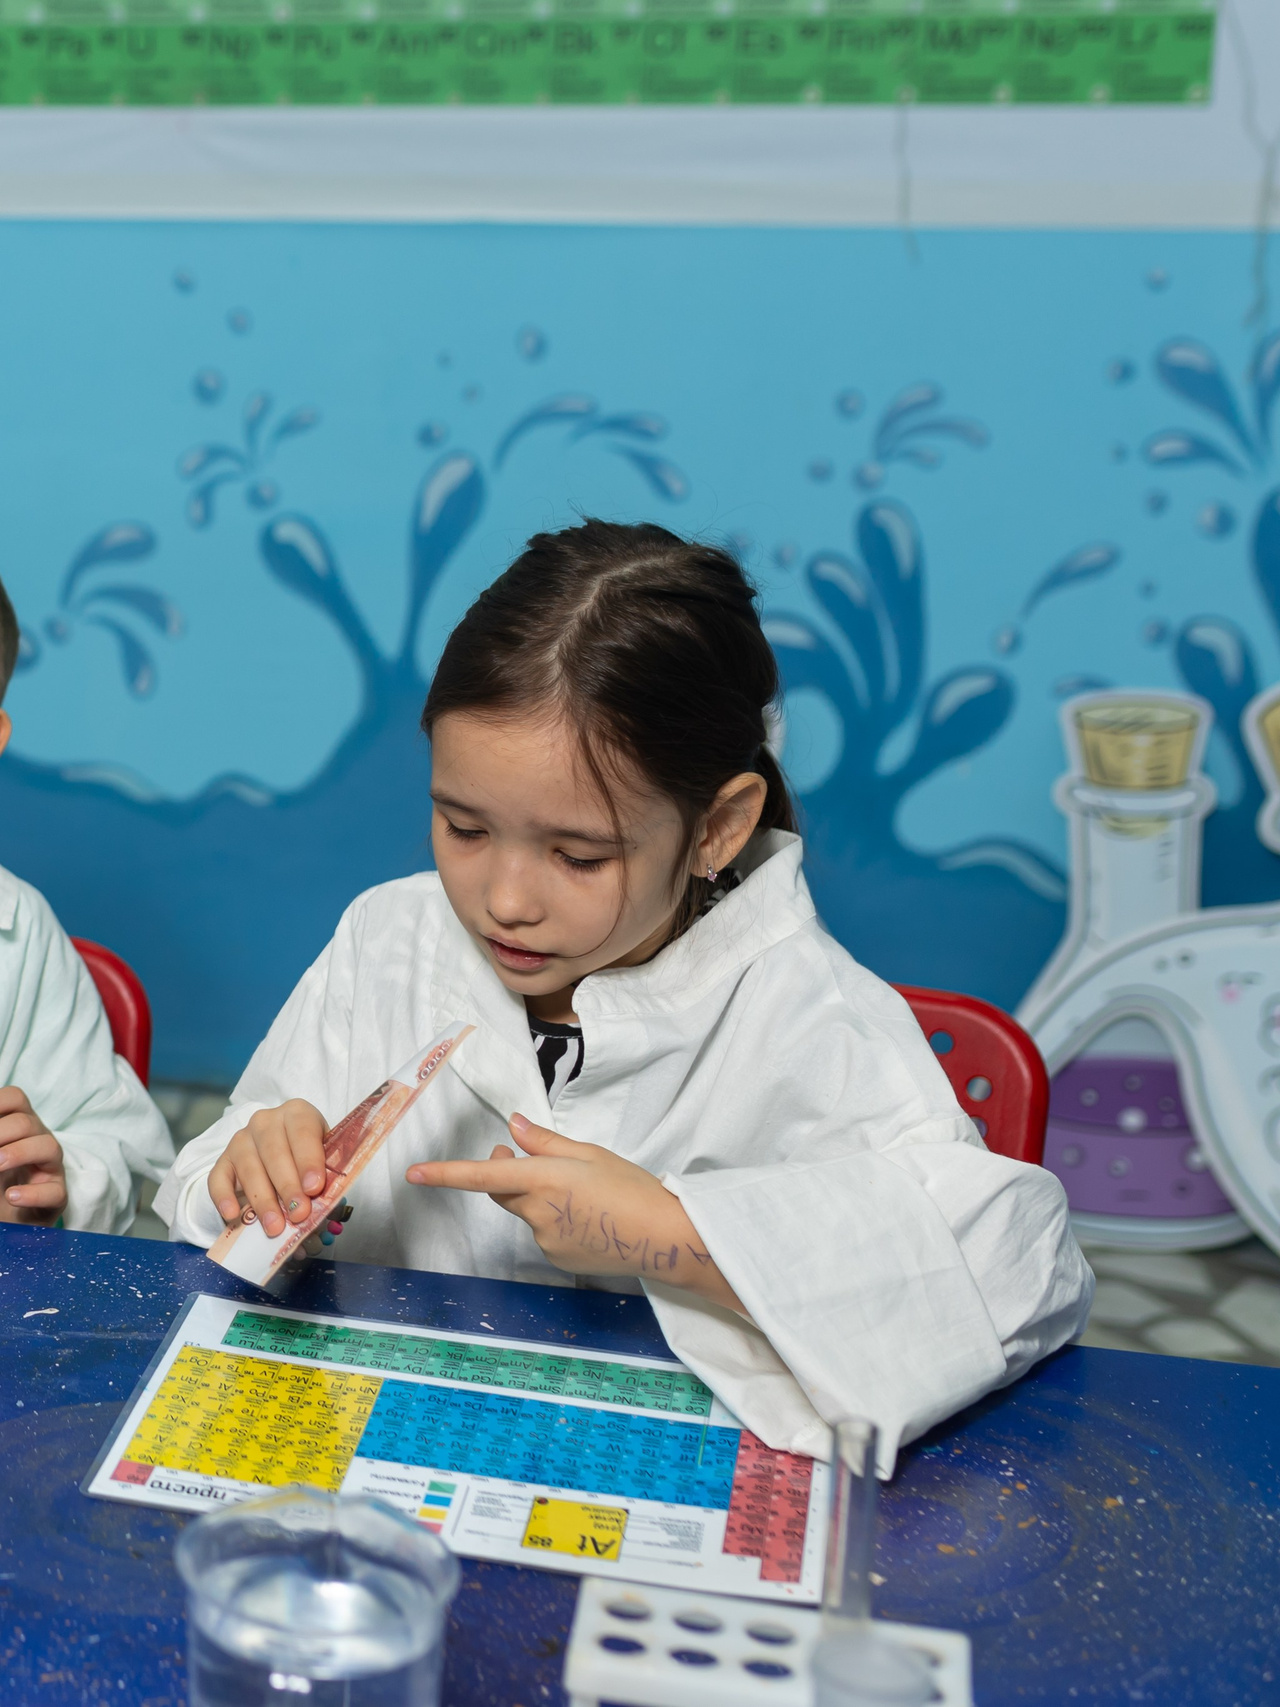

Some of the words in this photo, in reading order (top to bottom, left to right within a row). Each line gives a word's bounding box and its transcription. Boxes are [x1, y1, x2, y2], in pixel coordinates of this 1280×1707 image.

[678, 1454, 695, 1462] Hf
[150, 1480, 226, 1500] просто
[528, 1535, 552, 1548] 85
[578, 1534, 616, 1555] At
